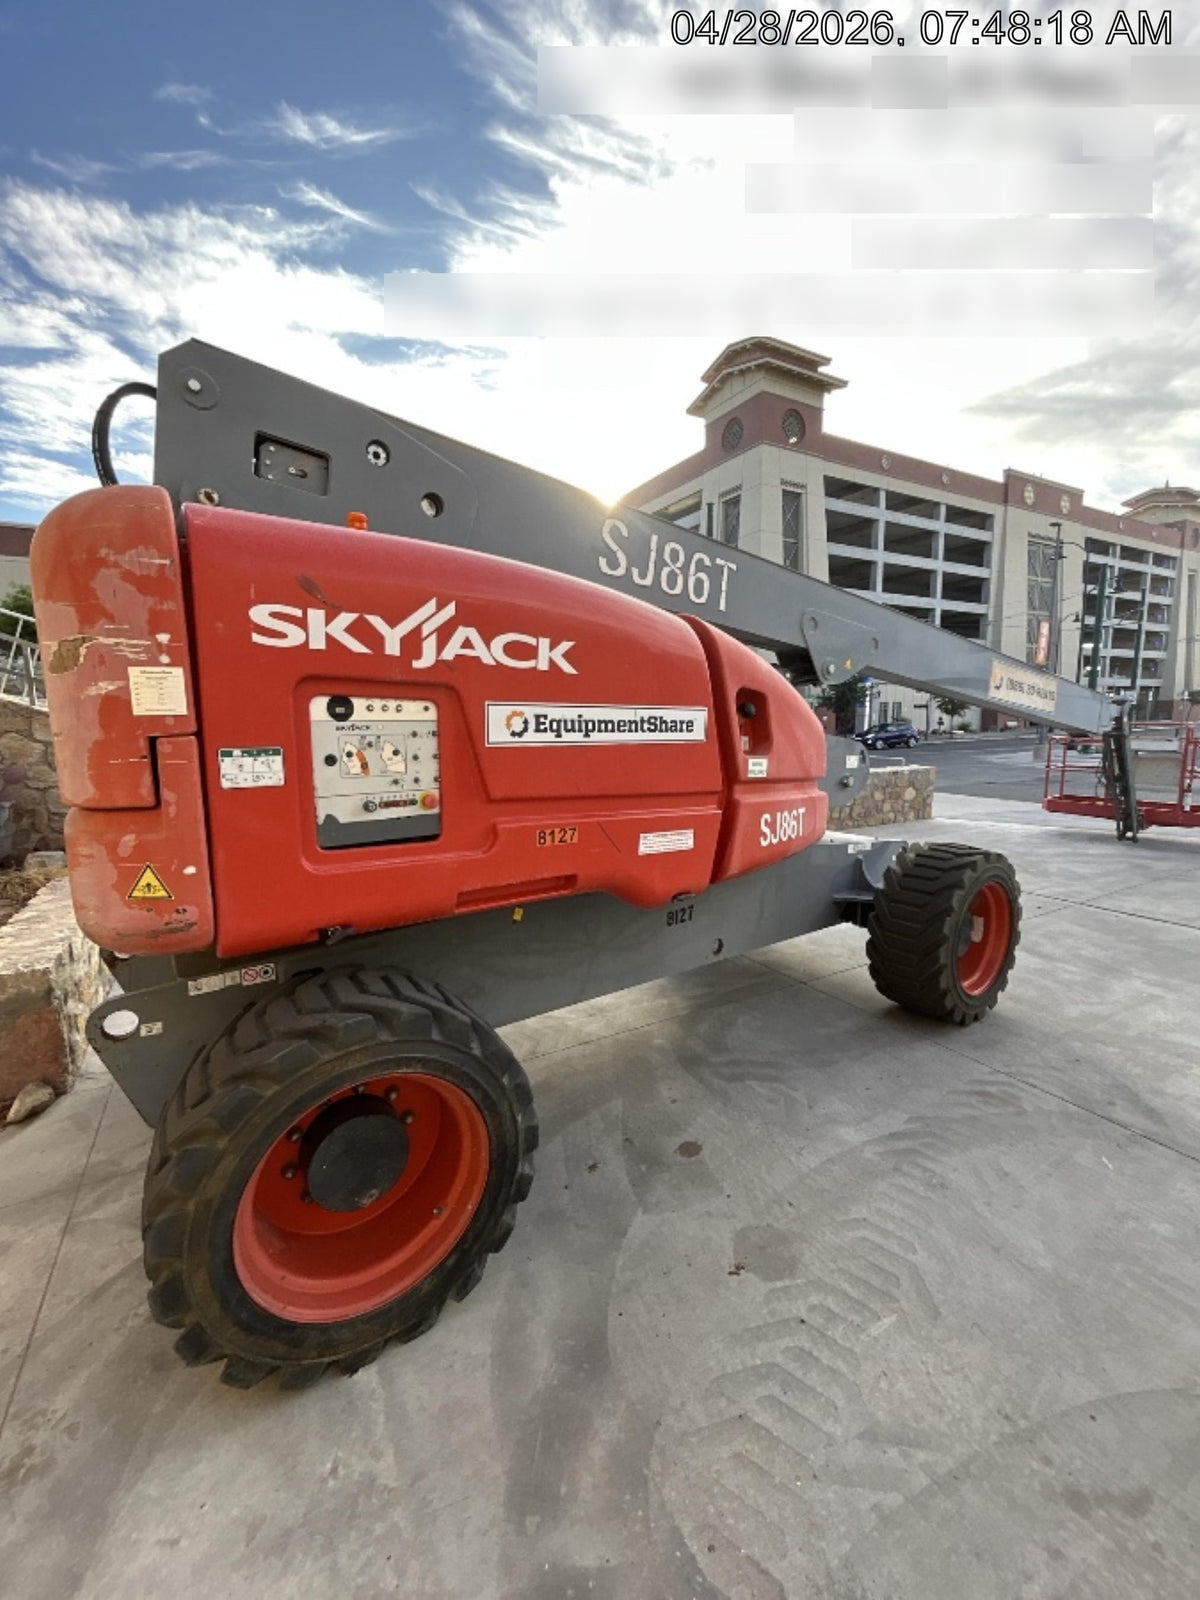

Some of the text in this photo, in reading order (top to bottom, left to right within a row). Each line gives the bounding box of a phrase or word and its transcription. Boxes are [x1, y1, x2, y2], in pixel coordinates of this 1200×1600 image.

[598, 518, 737, 612] SJ86T
[248, 597, 579, 675] SKYJACK
[533, 714, 694, 739] EquipmentShare
[538, 827, 577, 846] 8127
[759, 807, 806, 848] SJ86T
[666, 905, 695, 927] 8127
